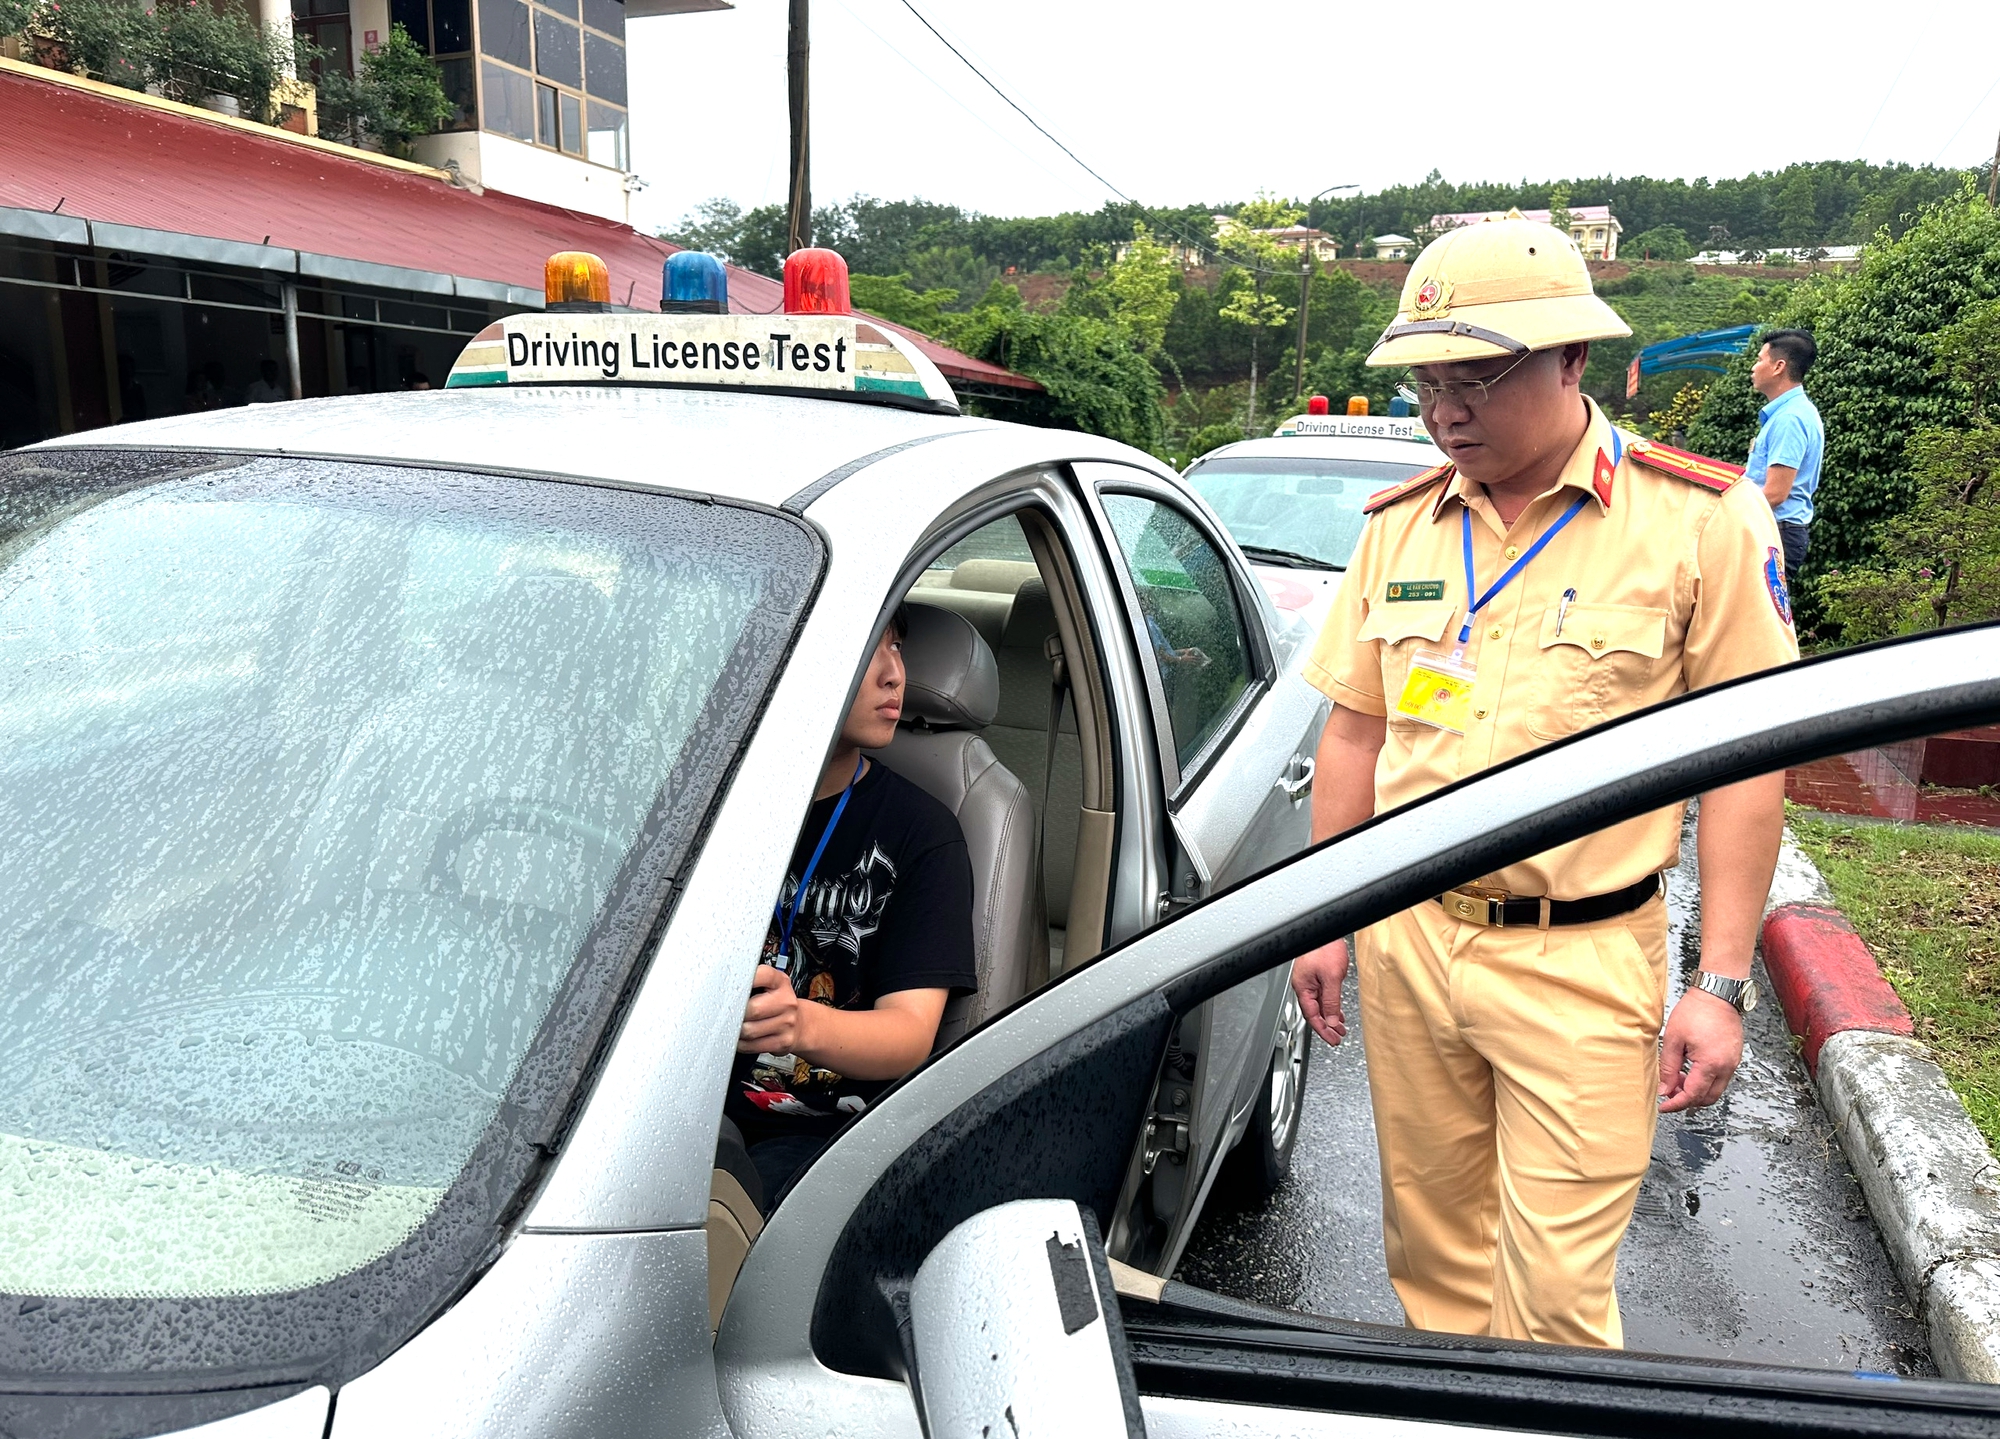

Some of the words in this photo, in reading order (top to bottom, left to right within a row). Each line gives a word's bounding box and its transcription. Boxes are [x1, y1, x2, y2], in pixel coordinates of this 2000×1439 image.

[507, 332, 619, 377] Driving
[631, 333, 760, 372] License
[770, 333, 847, 373] Test
[1297, 421, 1336, 436] Driving
[1340, 423, 1384, 435] License
[1388, 424, 1413, 436] Test
